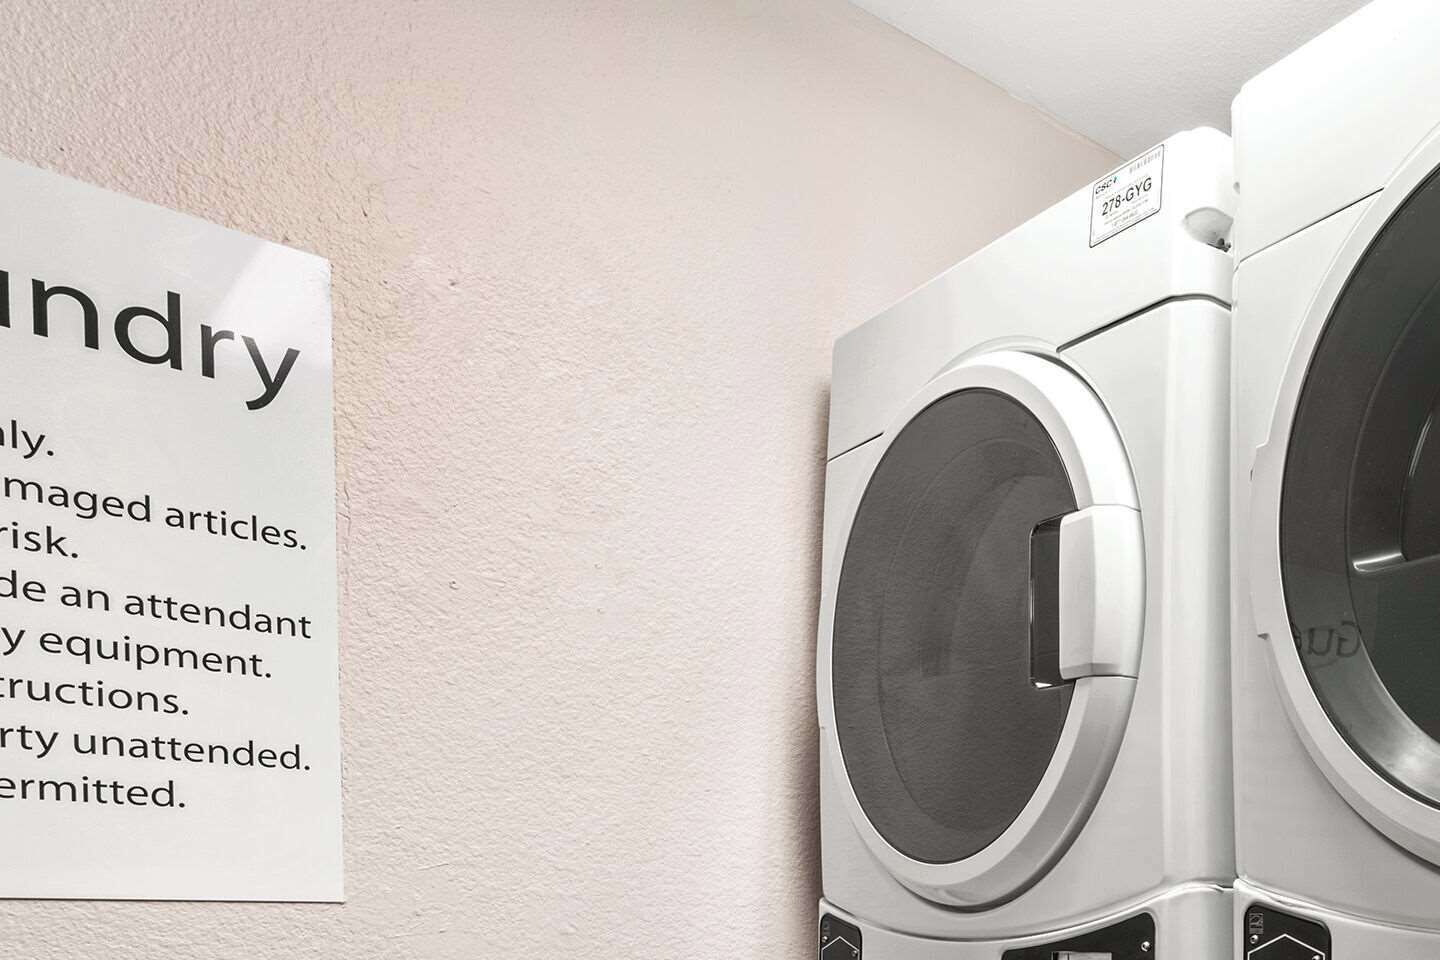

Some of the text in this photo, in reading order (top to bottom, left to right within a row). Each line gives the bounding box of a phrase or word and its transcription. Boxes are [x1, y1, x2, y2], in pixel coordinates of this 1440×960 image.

[1101, 177, 1152, 216] 278-GYG
[165, 507, 307, 548] articles.
[0, 569, 312, 639] de an attendant
[0, 627, 272, 679] y equipment.
[0, 725, 311, 771] rty unattended.
[0, 775, 185, 808] ermitted.
